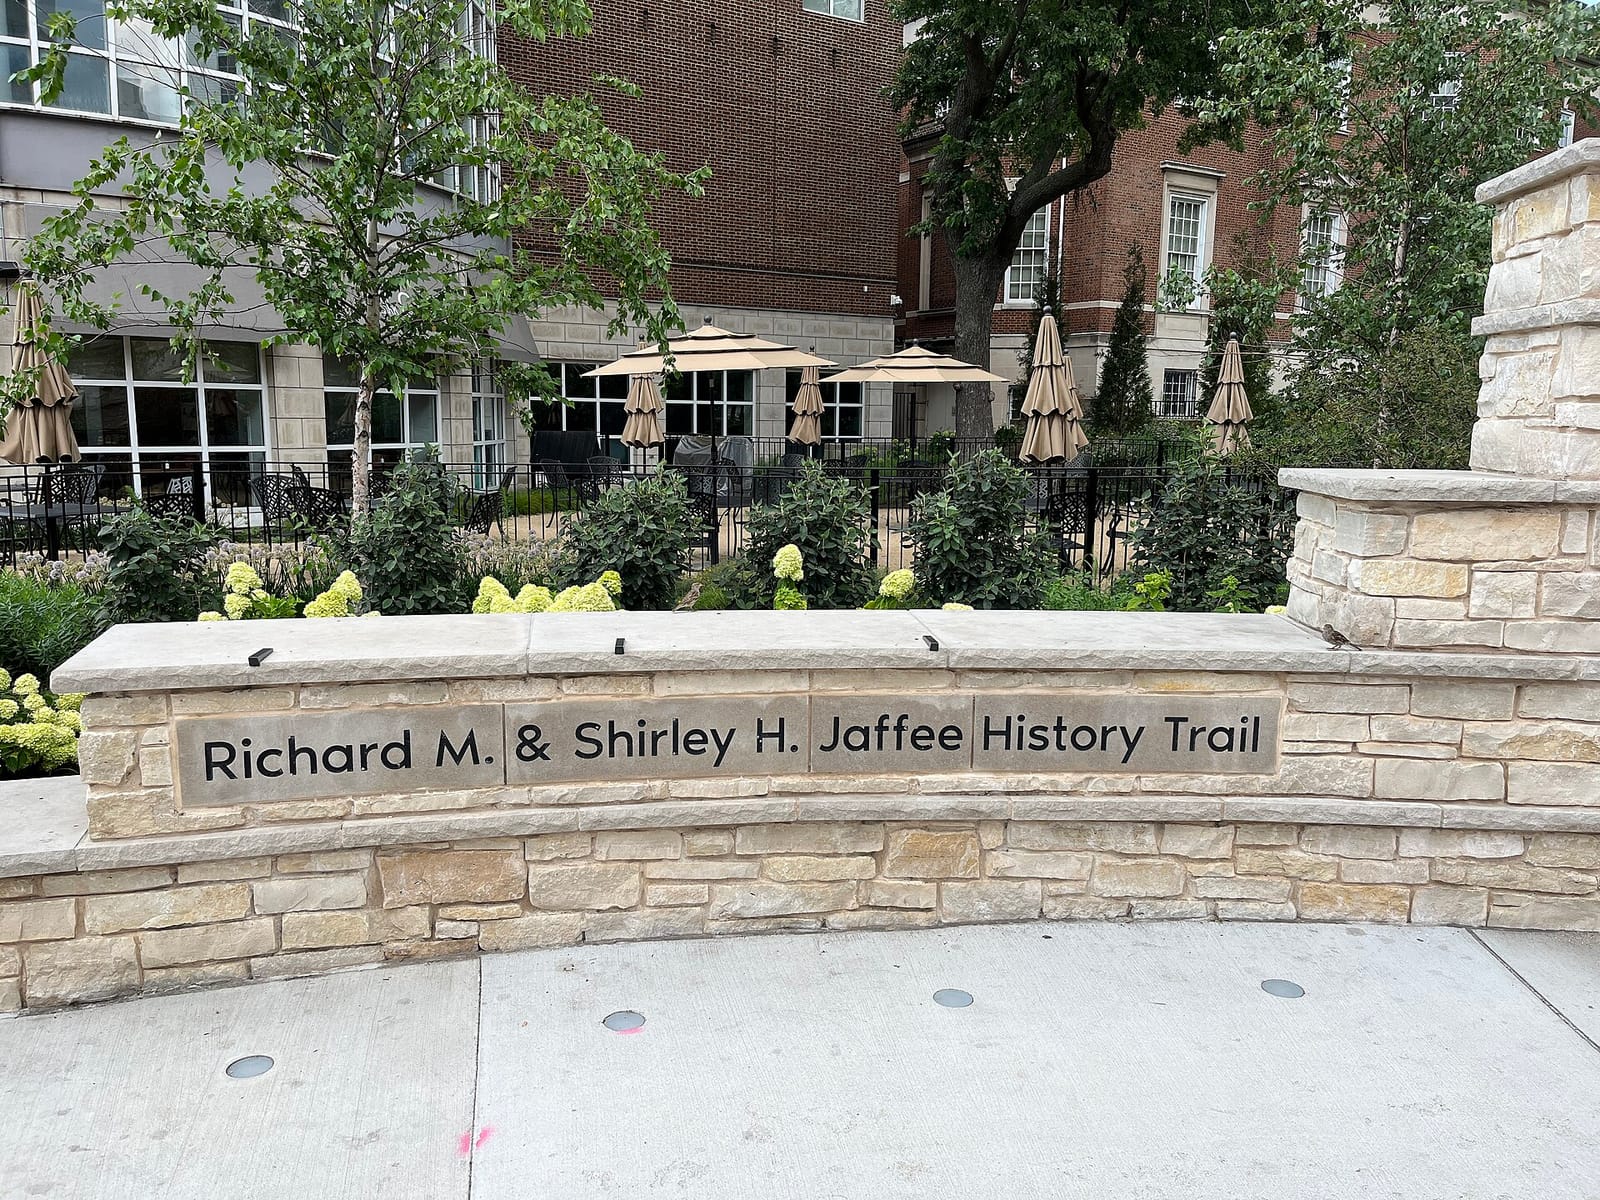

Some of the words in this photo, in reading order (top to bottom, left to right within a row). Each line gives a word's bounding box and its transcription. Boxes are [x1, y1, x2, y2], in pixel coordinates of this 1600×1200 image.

[204, 729, 412, 782] Richard
[435, 727, 495, 768] M.
[515, 724, 552, 762] &
[574, 718, 737, 768] Shirley
[756, 717, 799, 753] H.
[818, 713, 963, 752] Jaffee
[983, 714, 1146, 764] History
[1163, 716, 1261, 753] Trail
